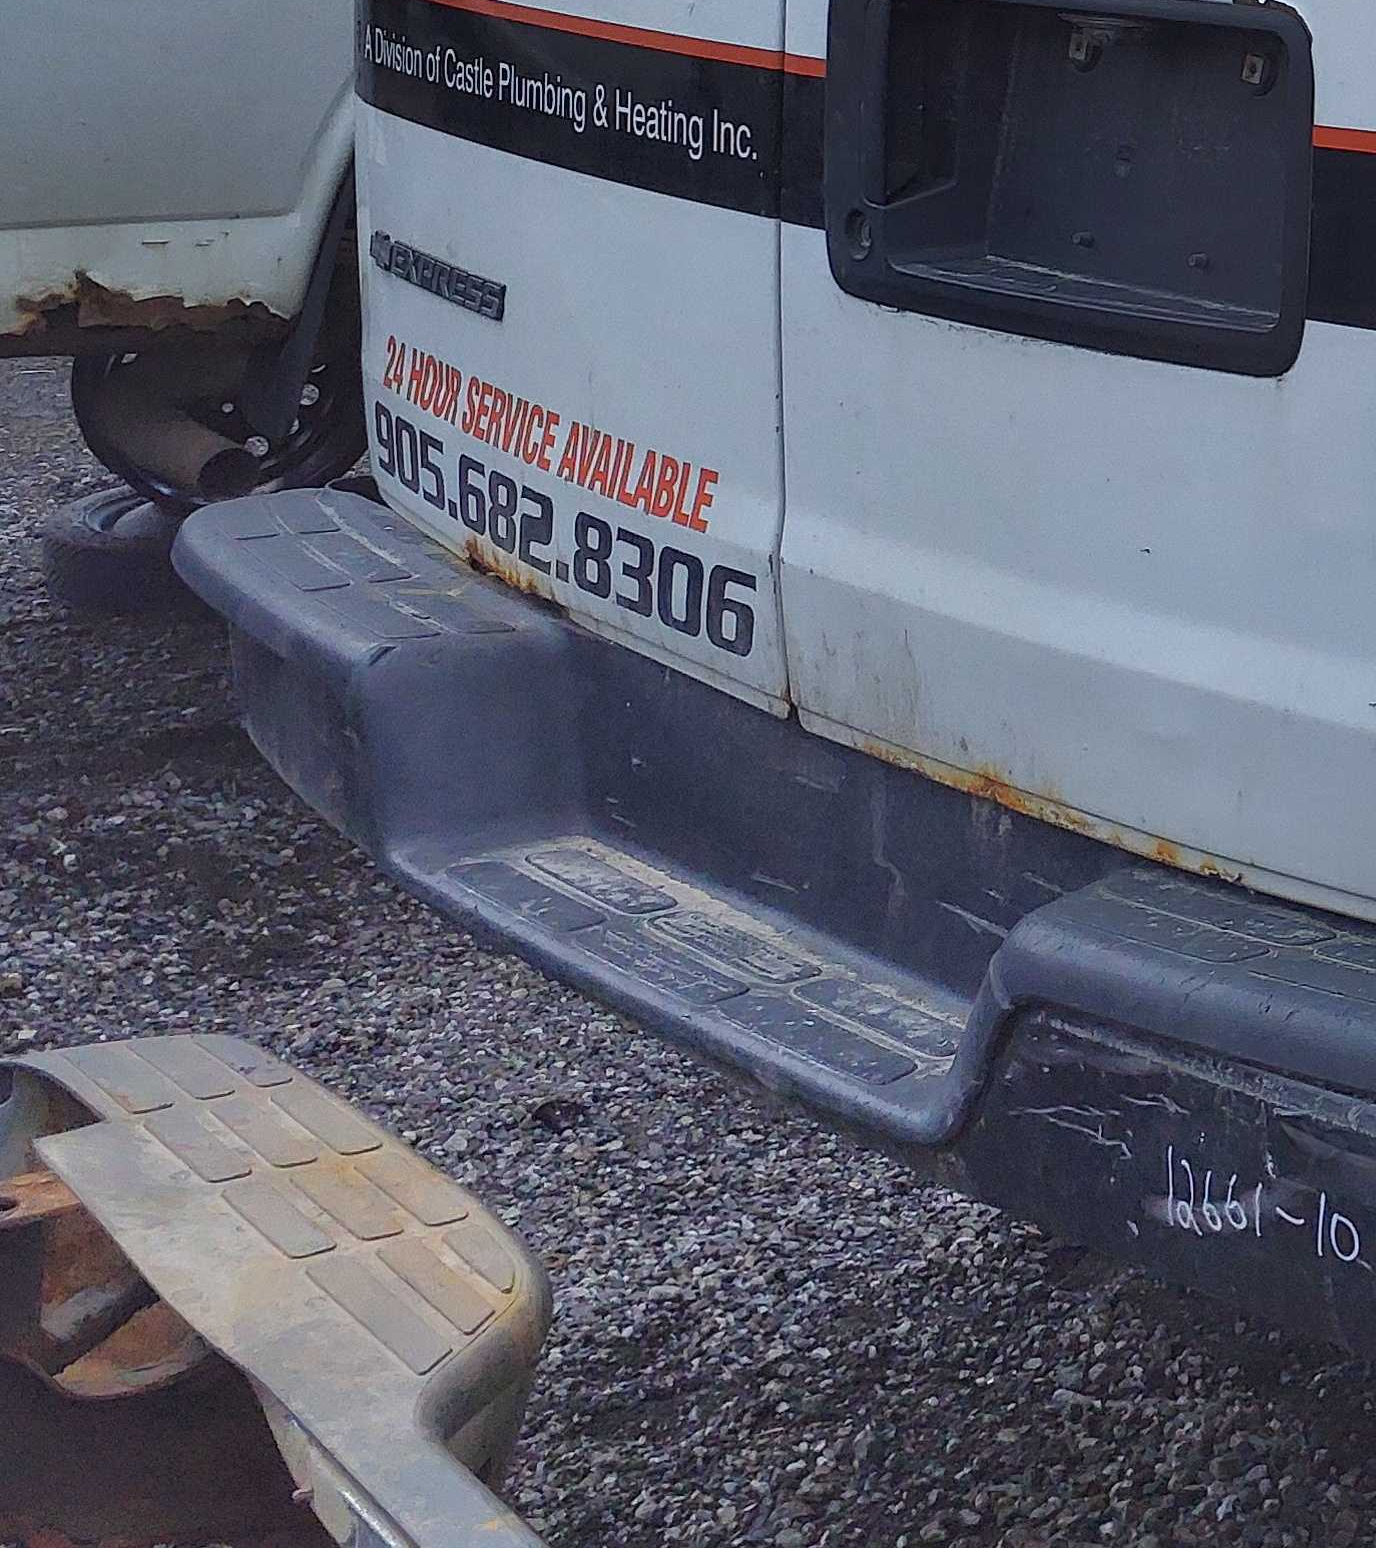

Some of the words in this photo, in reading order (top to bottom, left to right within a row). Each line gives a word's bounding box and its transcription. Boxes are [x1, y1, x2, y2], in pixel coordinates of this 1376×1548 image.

[364, 24, 373, 59] A
[375, 28, 423, 80] Division
[426, 45, 442, 84] of
[444, 48, 493, 99] Castle
[498, 62, 586, 133] Plumbing
[593, 83, 607, 127] &
[616, 88, 703, 160] Heating
[713, 108, 757, 160] Inc.
[391, 242, 503, 320] EXPRESS
[383, 335, 405, 394] 24
[407, 348, 462, 426] HOUR
[462, 376, 560, 471] SERVICE
[556, 421, 719, 533] AVAILABLE
[375, 401, 756, 657] 905.682.8306
[1167, 1145, 1360, 1261] 12661-10
